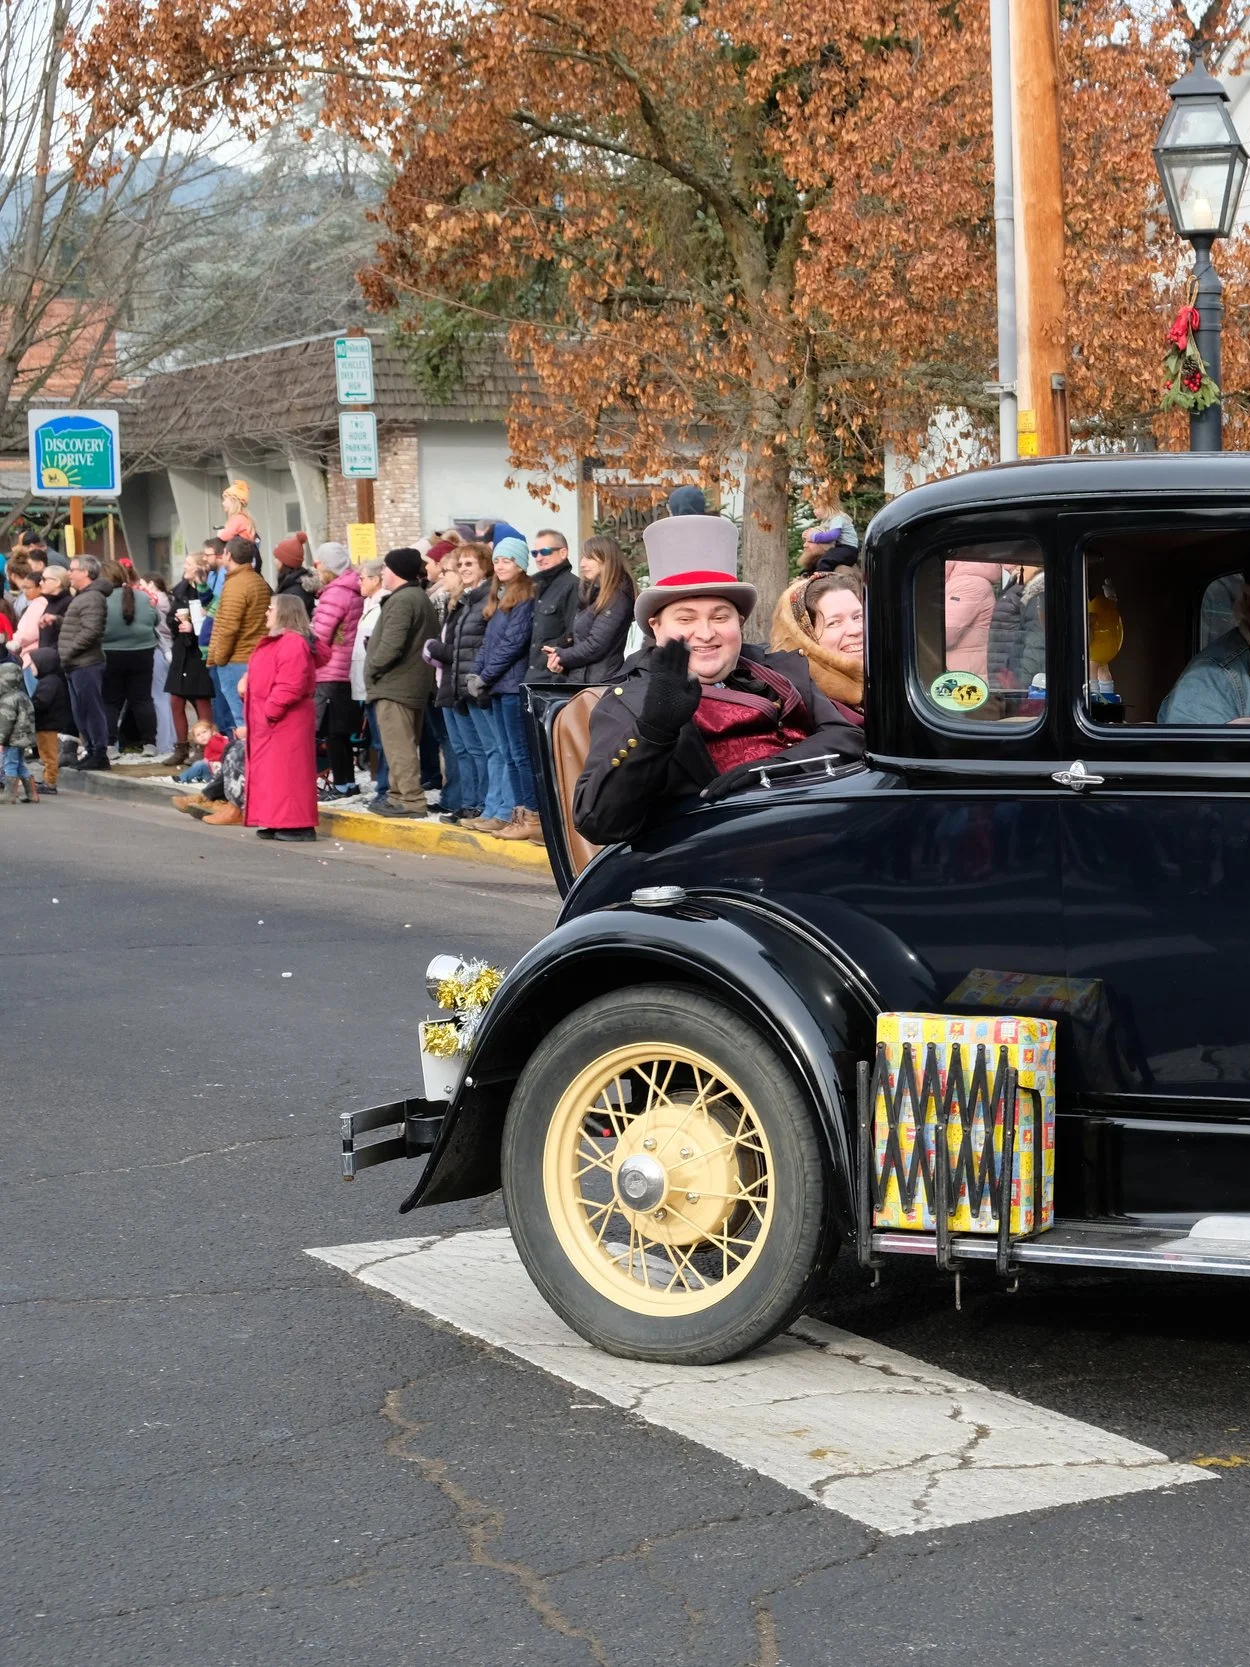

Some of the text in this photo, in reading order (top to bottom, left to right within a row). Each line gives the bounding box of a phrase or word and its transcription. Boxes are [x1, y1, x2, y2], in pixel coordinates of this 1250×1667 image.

[347, 345, 368, 353] PARKING
[341, 360, 366, 369] VEHICLES
[340, 371, 354, 380] OVER
[350, 420, 364, 428] TWO
[349, 431, 367, 440] HOUR
[44, 438, 105, 452] DISCOVERY
[345, 443, 372, 452] PARKING
[58, 453, 95, 466] DRIVE
